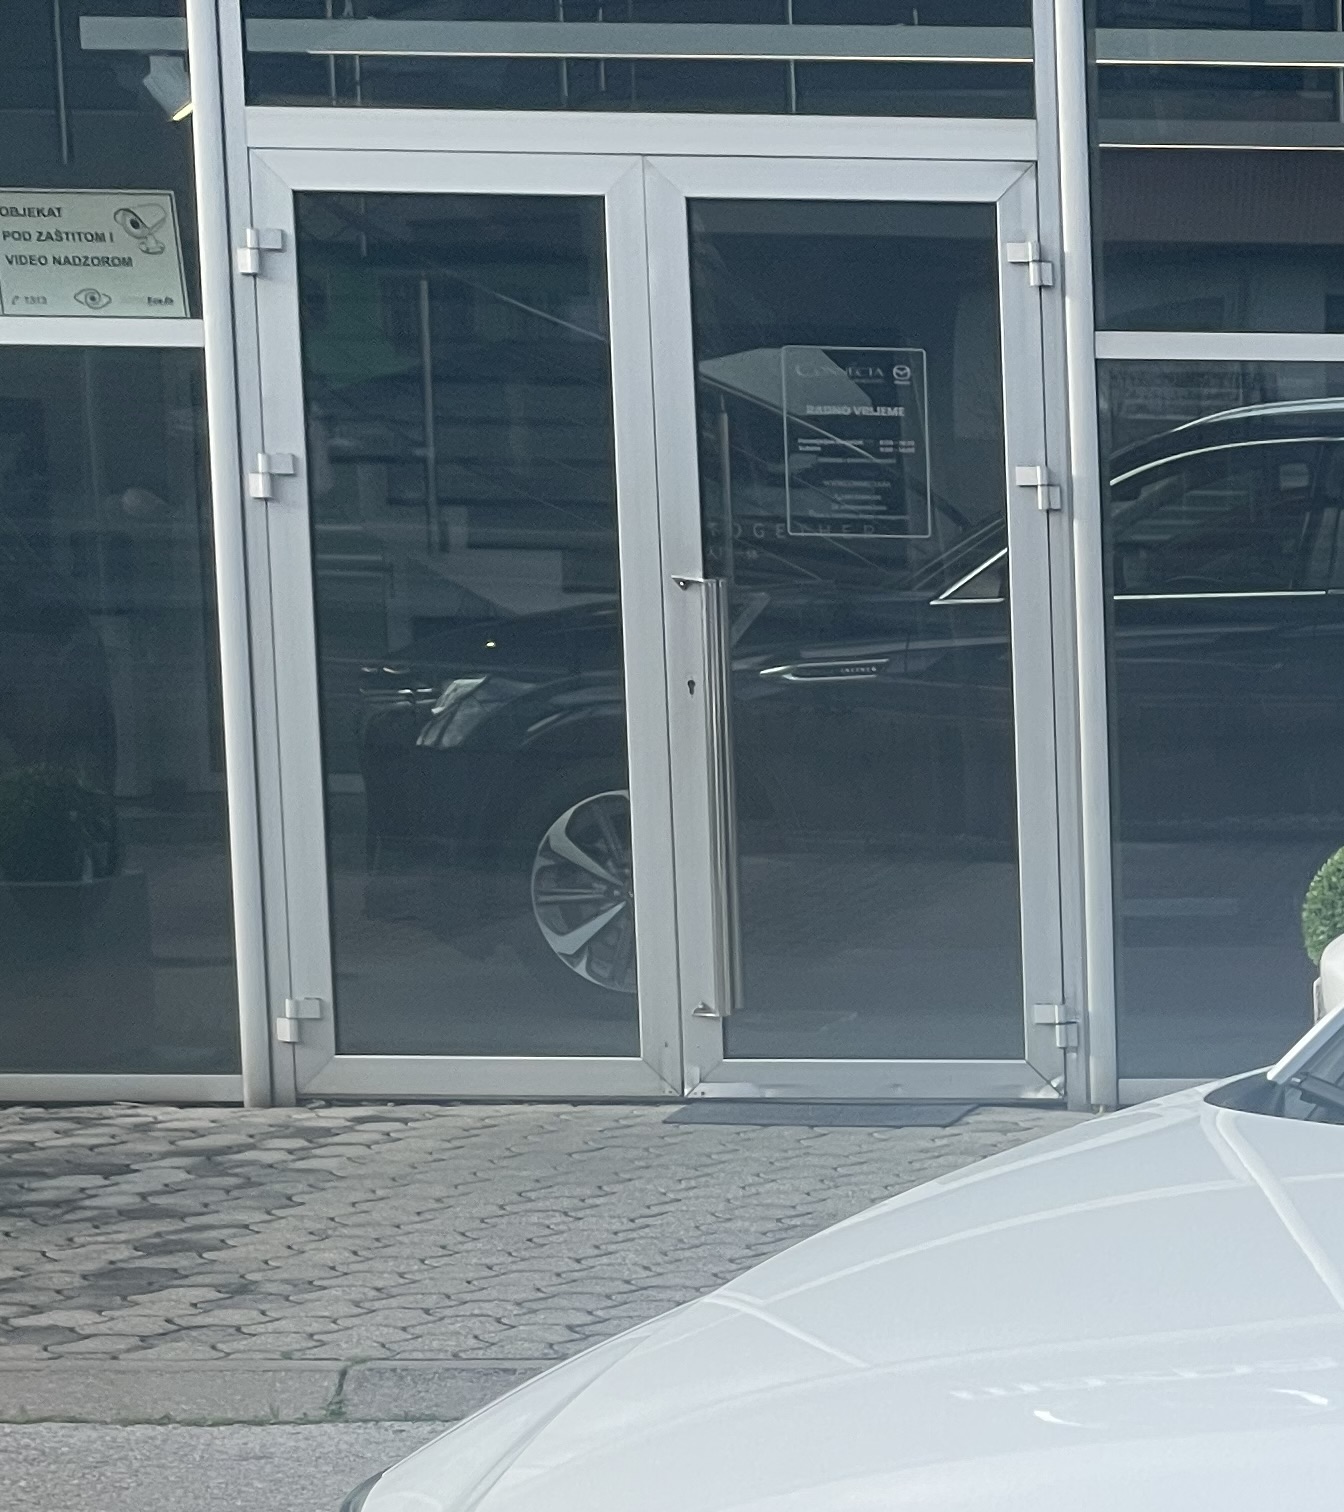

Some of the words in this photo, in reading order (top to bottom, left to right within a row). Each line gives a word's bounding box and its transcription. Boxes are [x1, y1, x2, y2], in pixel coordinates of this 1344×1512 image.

[0, 206, 62, 218] OBJEKAT
[2, 230, 32, 242] POD
[36, 228, 106, 243] ZAŠTITOM
[5, 254, 48, 266] VIDEO
[52, 255, 133, 268] NADZOROM
